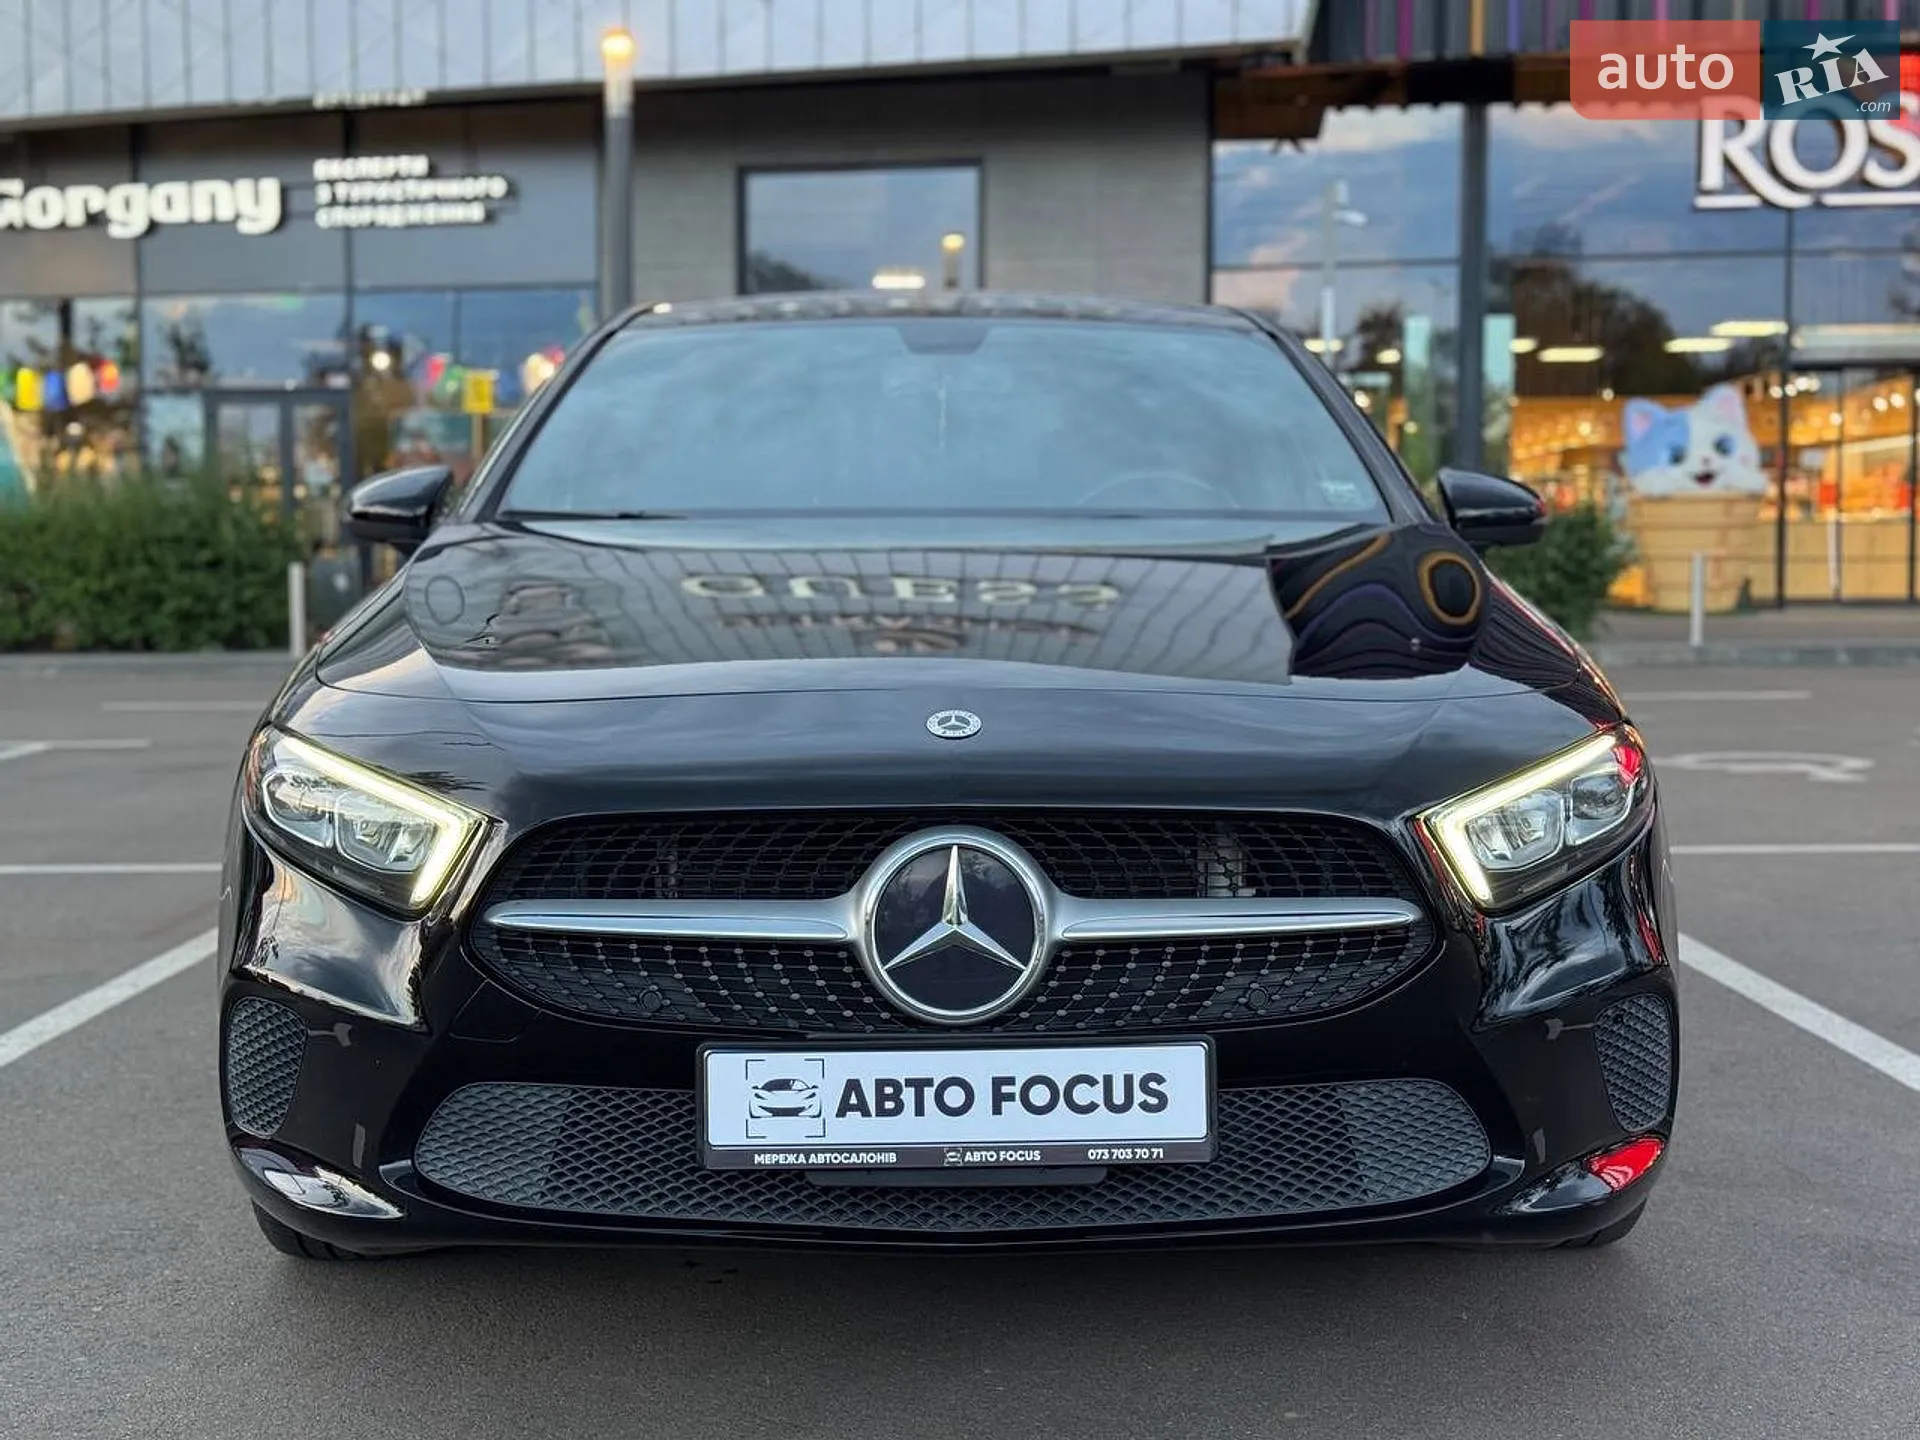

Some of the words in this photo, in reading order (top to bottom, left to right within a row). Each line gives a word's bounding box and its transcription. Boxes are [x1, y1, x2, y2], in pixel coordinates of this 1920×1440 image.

[835, 1077, 976, 1118] АВТО
[991, 1072, 1169, 1116] FOCUS
[754, 1153, 806, 1165] МЕРЕЖА
[808, 1152, 897, 1164] АВТОСАЛОНІВ
[964, 1151, 998, 1162] АВТО
[1000, 1150, 1041, 1161] FOCUS
[1088, 1148, 1110, 1160] 073
[1111, 1148, 1133, 1159] 703
[1134, 1148, 1149, 1159] 70
[1151, 1148, 1164, 1159] 71
